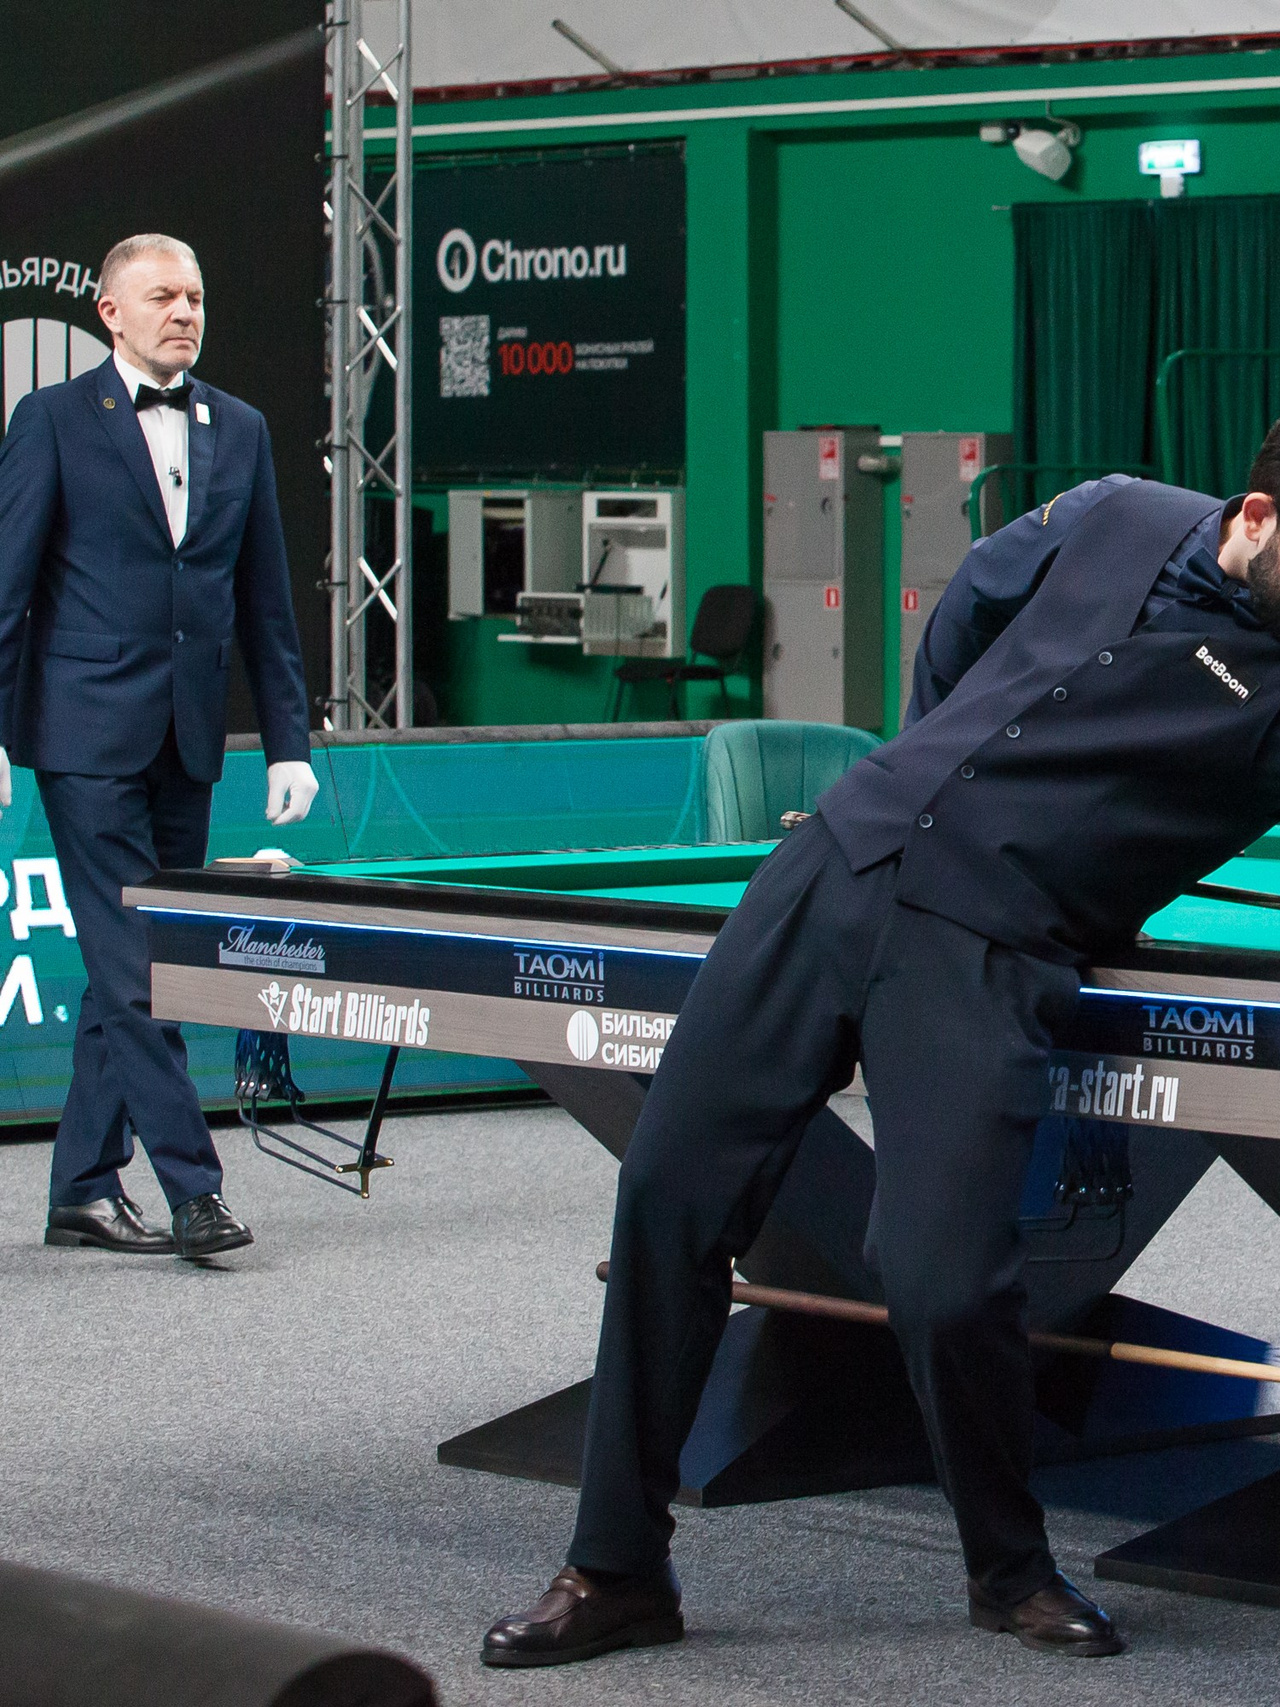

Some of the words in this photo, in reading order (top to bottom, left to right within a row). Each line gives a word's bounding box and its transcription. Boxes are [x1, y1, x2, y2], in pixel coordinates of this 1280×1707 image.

[0, 256, 101, 302] ЬЯРДН
[481, 238, 627, 283] Chrono.ru
[498, 342, 525, 376] 10
[1195, 645, 1249, 699] BetBoom
[0, 857, 77, 941] Д
[219, 922, 326, 960] Manchester
[289, 983, 342, 1035] Start
[343, 992, 430, 1046] Billiards
[513, 981, 604, 1003] BILLIARDS
[1143, 1037, 1255, 1061] BILLIARDS
